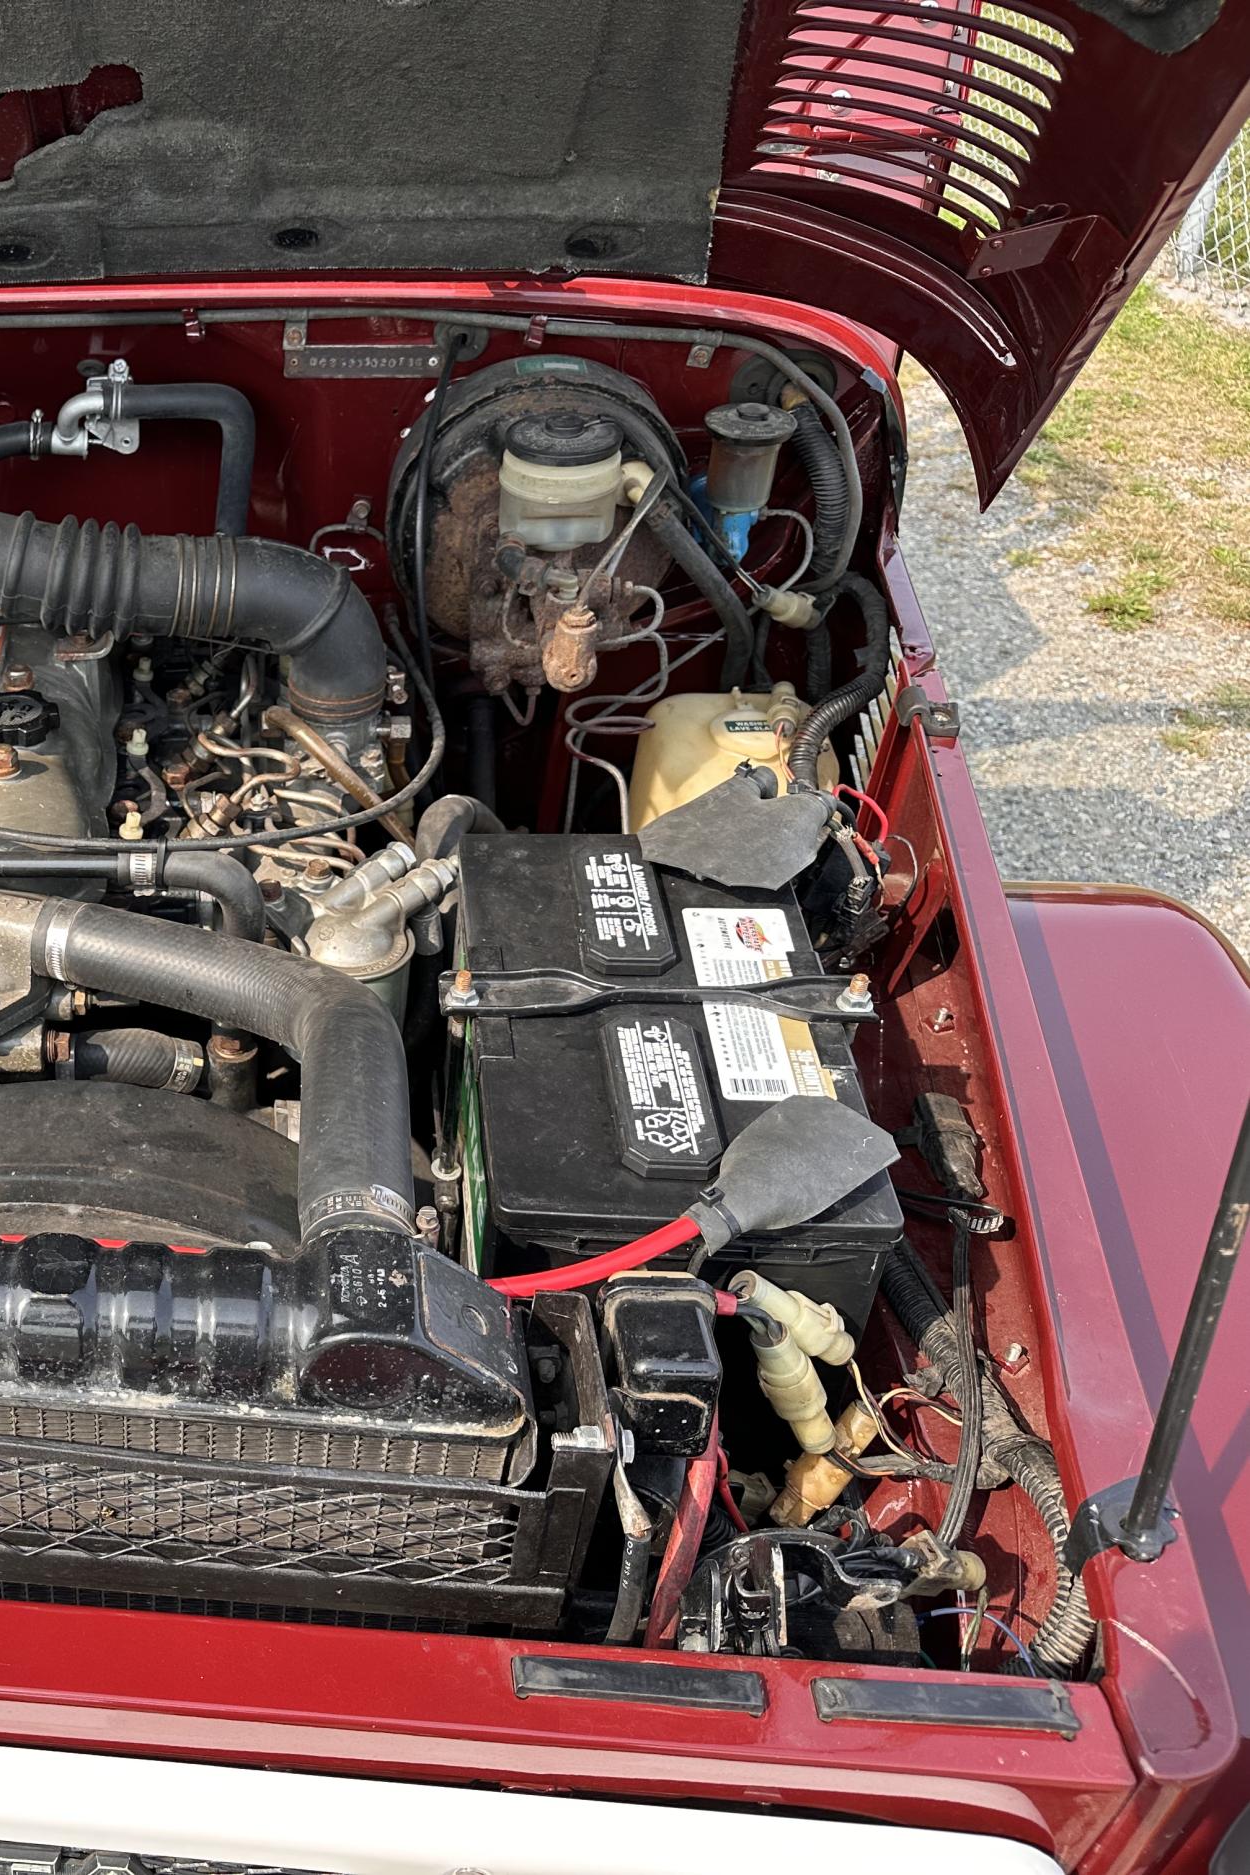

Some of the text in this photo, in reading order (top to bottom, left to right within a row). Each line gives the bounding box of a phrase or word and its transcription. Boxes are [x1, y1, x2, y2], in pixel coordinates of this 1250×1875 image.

[632, 872, 650, 900] DANGER
[641, 908, 658, 935] POISON
[717, 918, 732, 949] AUTOMOTIVE
[748, 917, 761, 950] INTERSTATE
